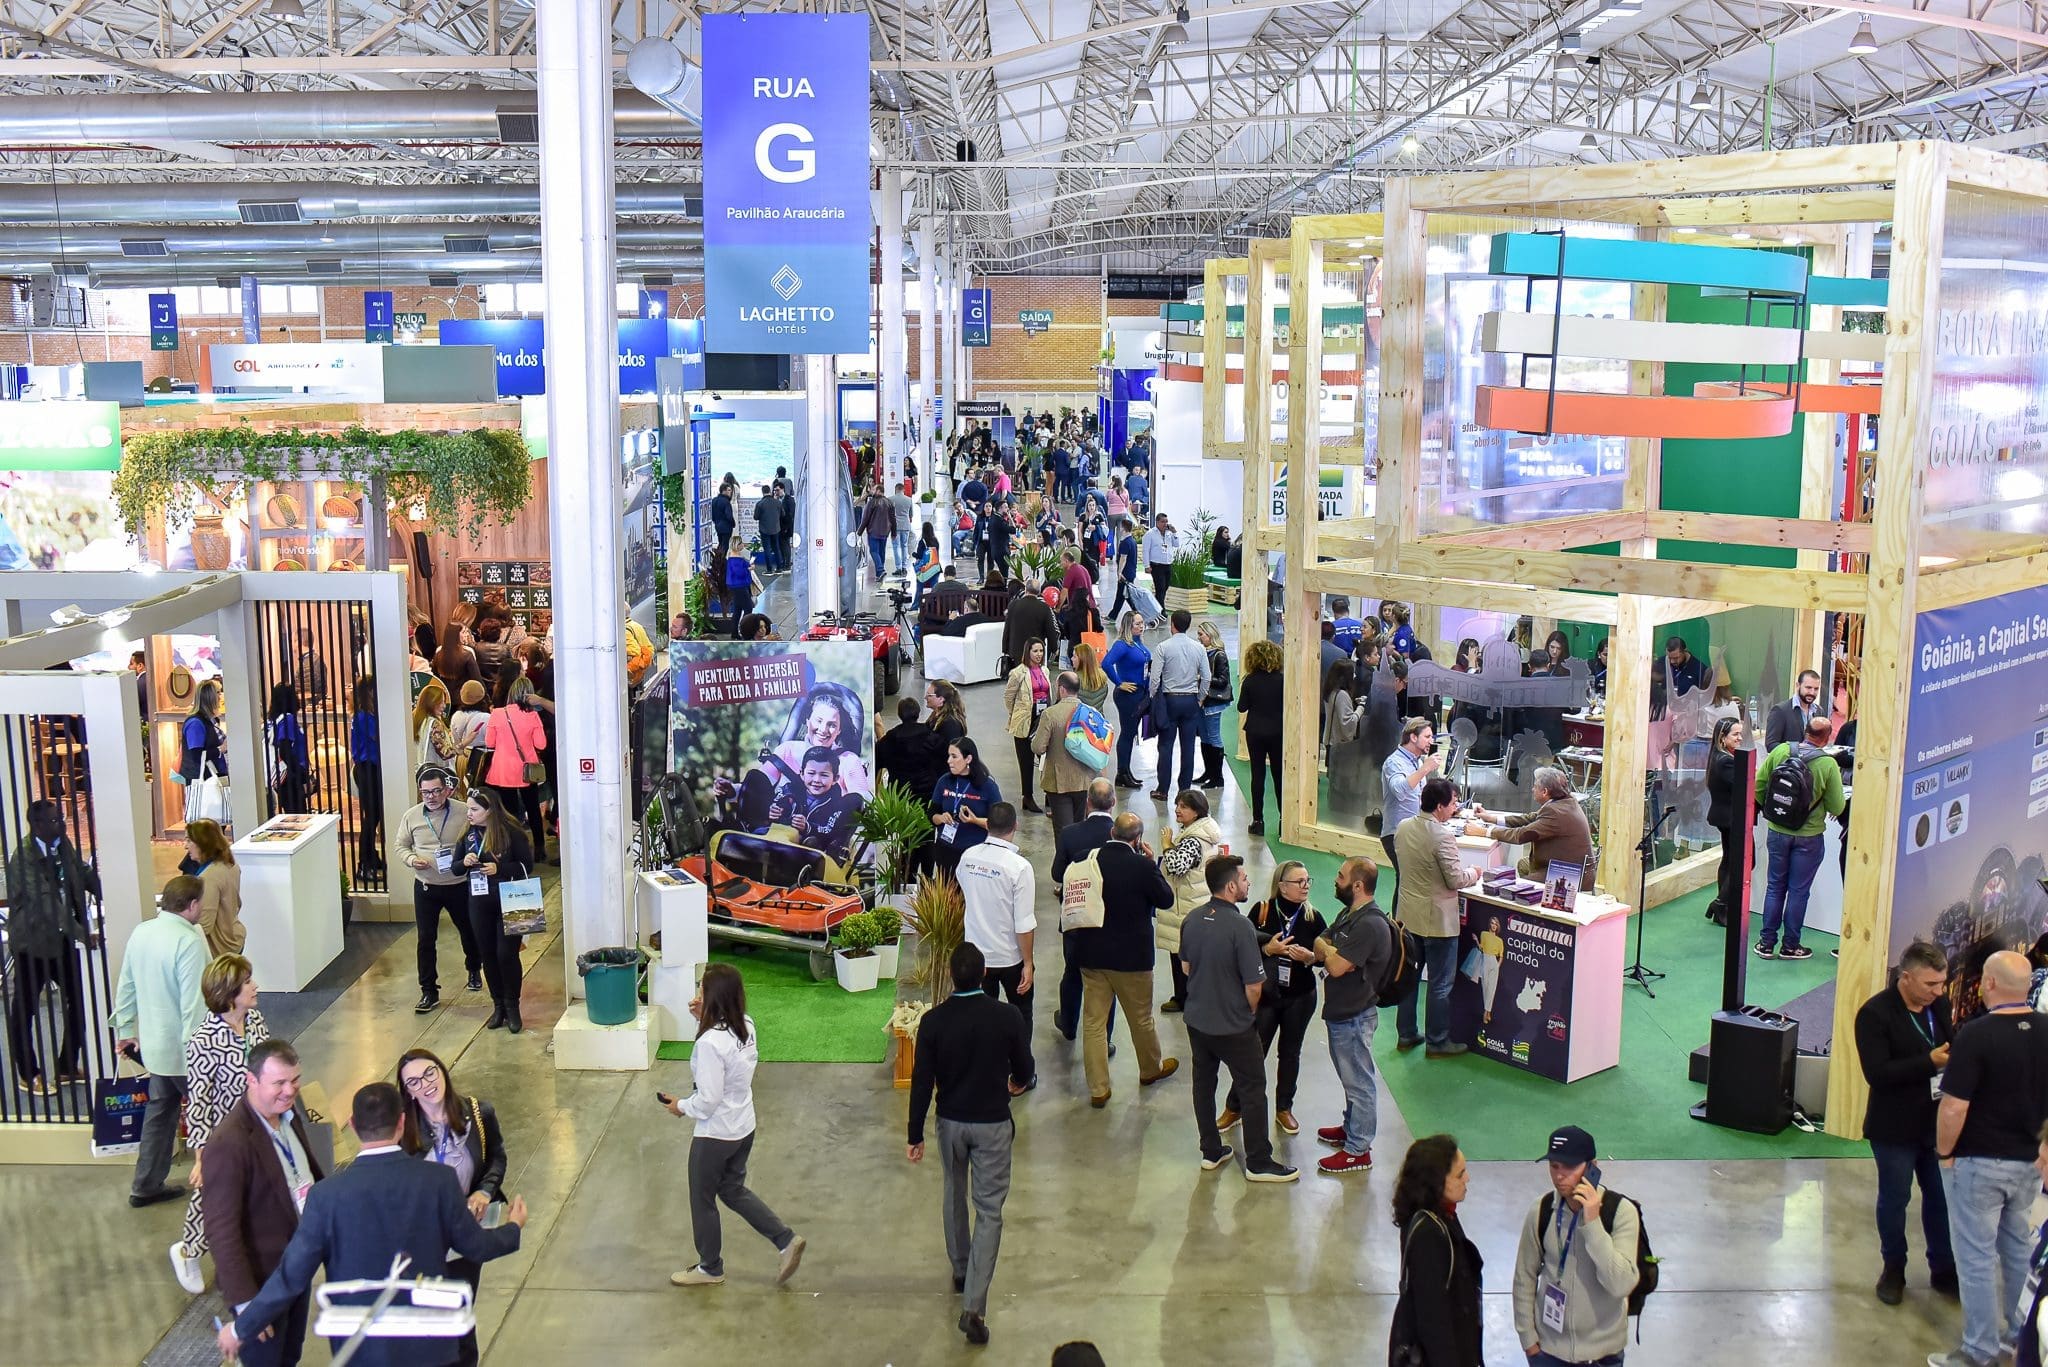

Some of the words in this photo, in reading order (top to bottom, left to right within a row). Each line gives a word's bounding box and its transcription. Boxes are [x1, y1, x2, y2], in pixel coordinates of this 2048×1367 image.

[754, 77, 815, 98] RUA
[755, 123, 816, 183] G
[727, 206, 780, 219] Pavilhão
[783, 206, 845, 219] Araucária
[159, 312, 169, 323] J
[395, 313, 425, 324] SAÍDA
[740, 306, 835, 322] LAGHETTO
[971, 307, 983, 318] G
[1020, 312, 1052, 322] SAÍDA
[767, 324, 807, 334] HOTÉIS
[1937, 308, 2000, 356] BORA
[515, 348, 538, 367] dos
[233, 359, 261, 373] GOL
[959, 404, 999, 413] INFORMAÇÕES
[1921, 634, 1975, 672] Goiânia,
[1978, 635, 1985, 656] a
[1988, 617, 2030, 655] Capital
[694, 667, 741, 685] AVENTURA
[744, 666, 750, 680] E
[753, 660, 800, 680] DIVERSÃO
[699, 686, 723, 702] PARA
[726, 683, 751, 700] TODA
[755, 683, 760, 697] A
[763, 678, 801, 697] FAMÍLIA!
[1918, 750, 1925, 762] Os
[1926, 744, 1951, 760] melhores
[1952, 734, 1973, 751] festivais
[1507, 937, 1547, 955] capital
[1549, 946, 1565, 960] da
[1507, 951, 1539, 968] moda
[1486, 1038, 1505, 1049] GOIÁS
